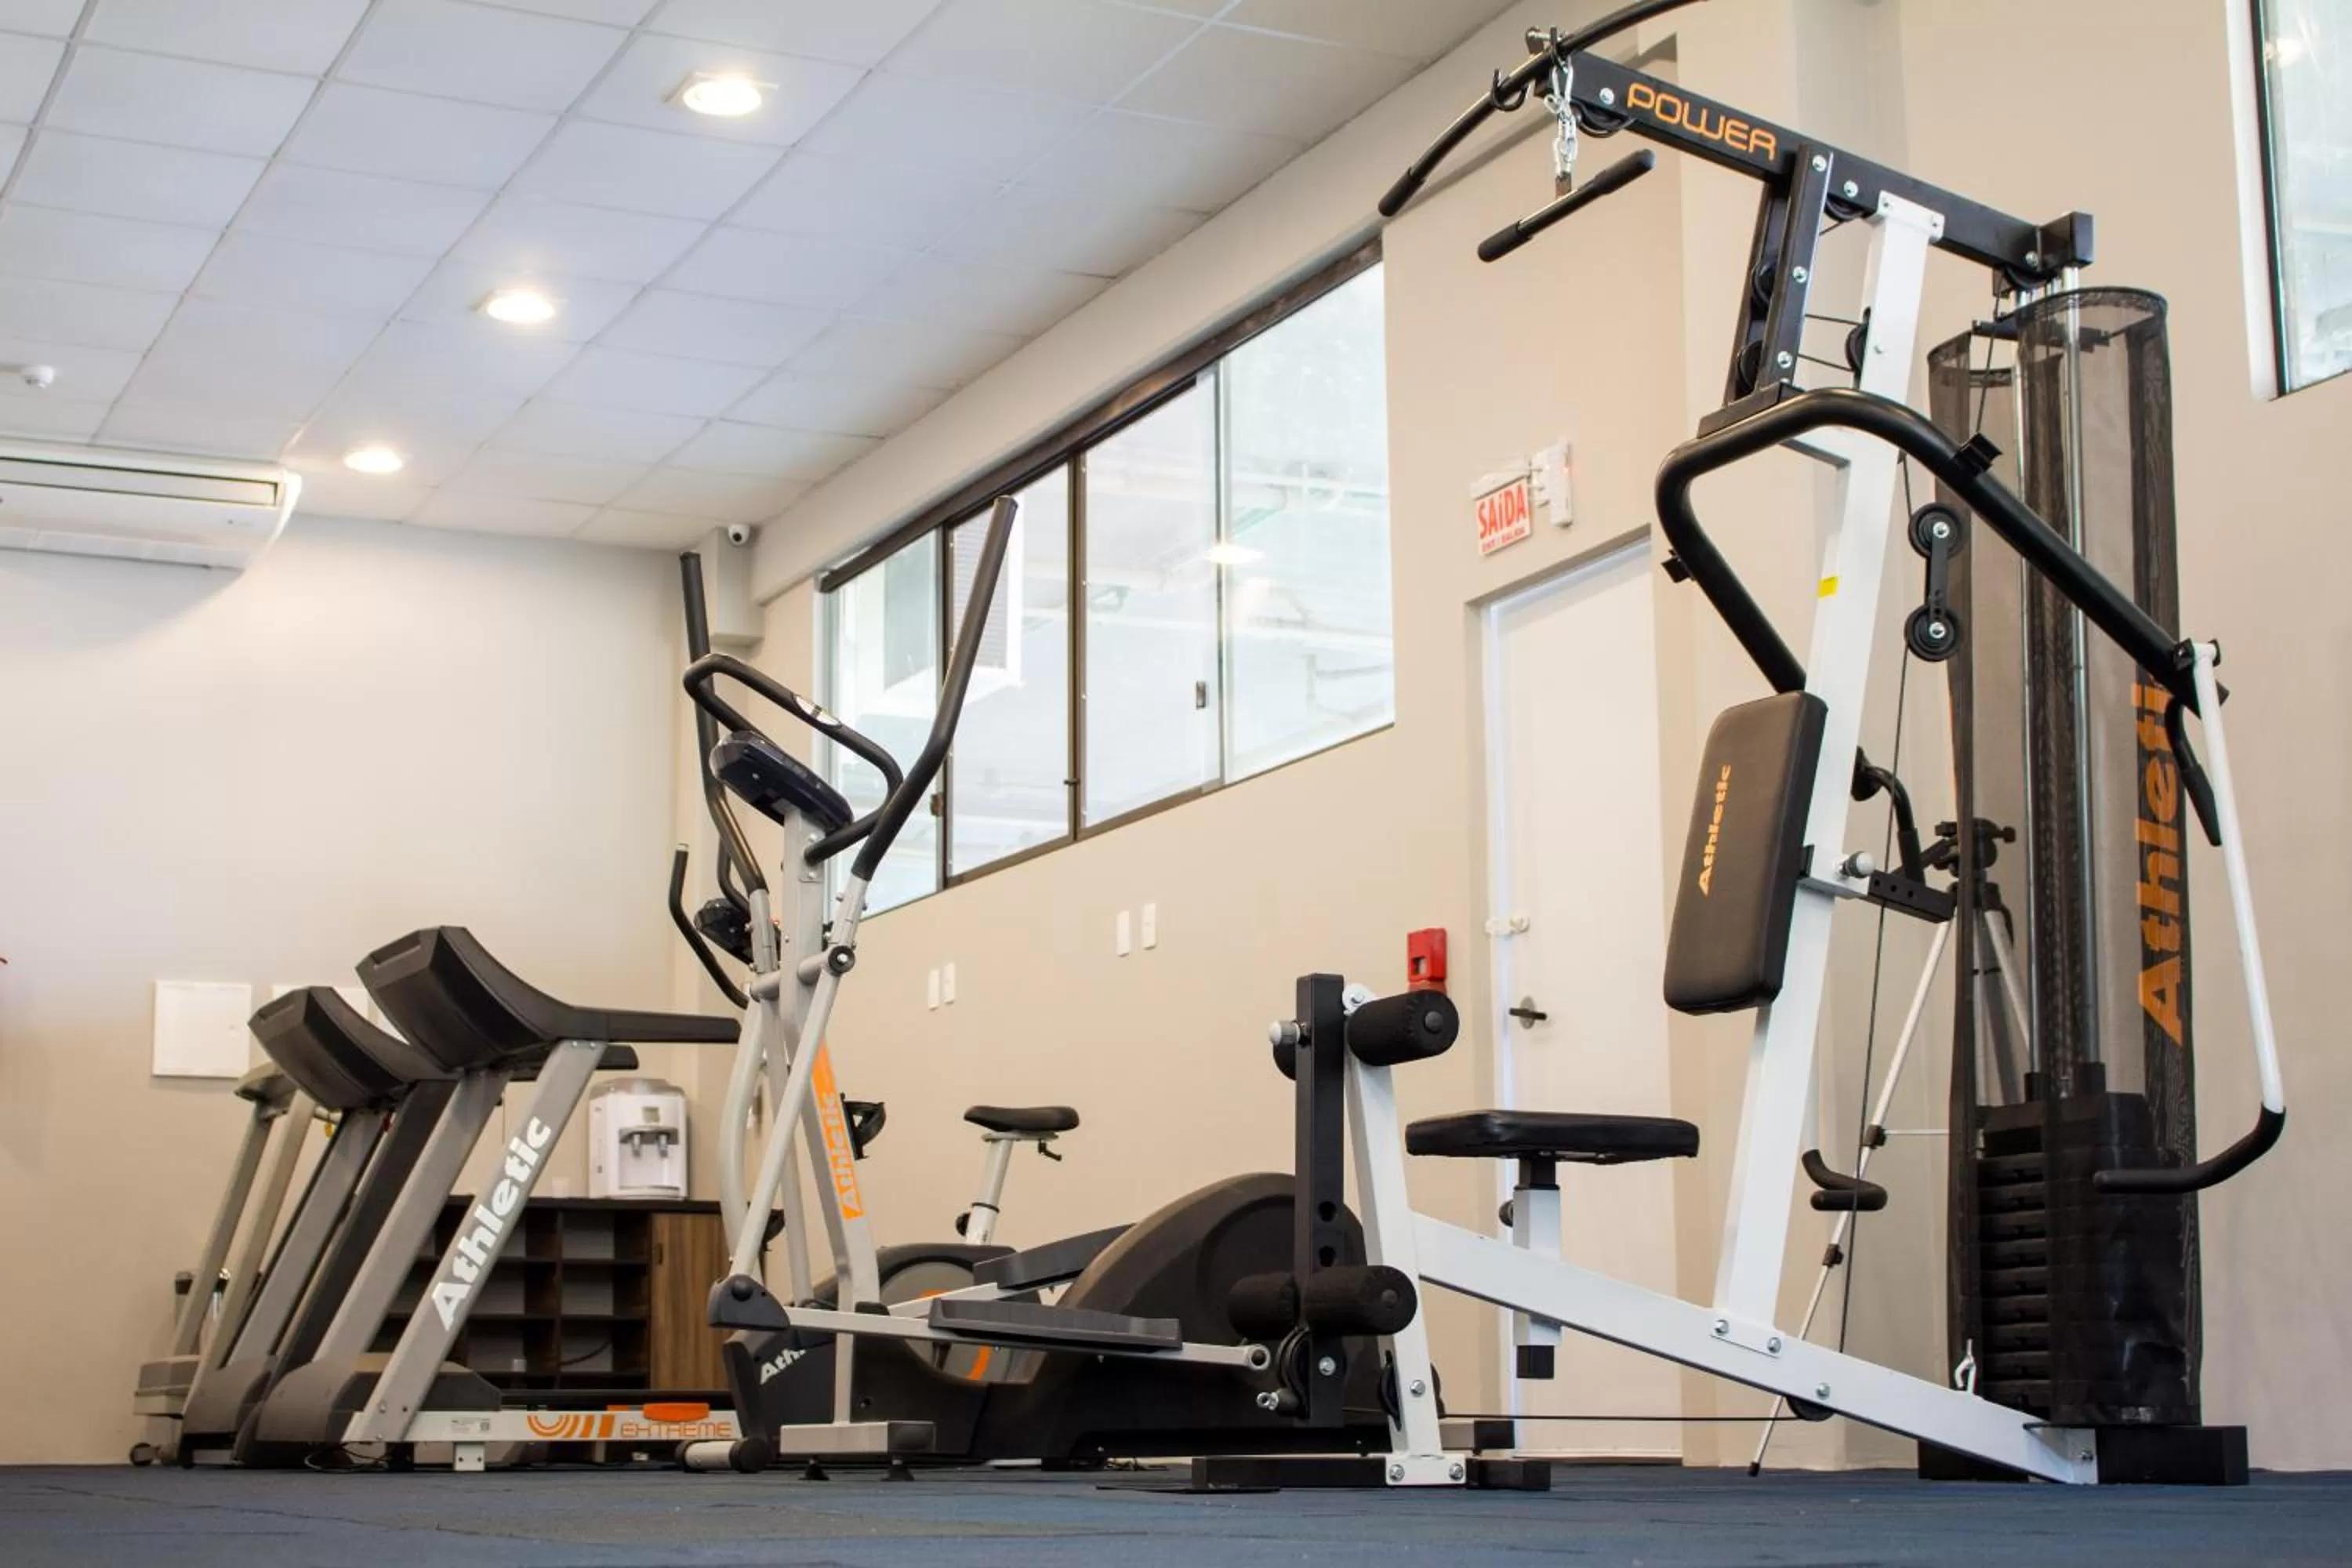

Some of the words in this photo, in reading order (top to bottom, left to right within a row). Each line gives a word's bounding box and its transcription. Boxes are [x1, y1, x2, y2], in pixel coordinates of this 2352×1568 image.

[1627, 82, 1777, 161] POWER
[1699, 764, 1731, 895] Athletic
[2131, 682, 2183, 1046] Athleti
[432, 1116, 551, 1331] Athletic
[621, 1421, 731, 1438] EXTREME
